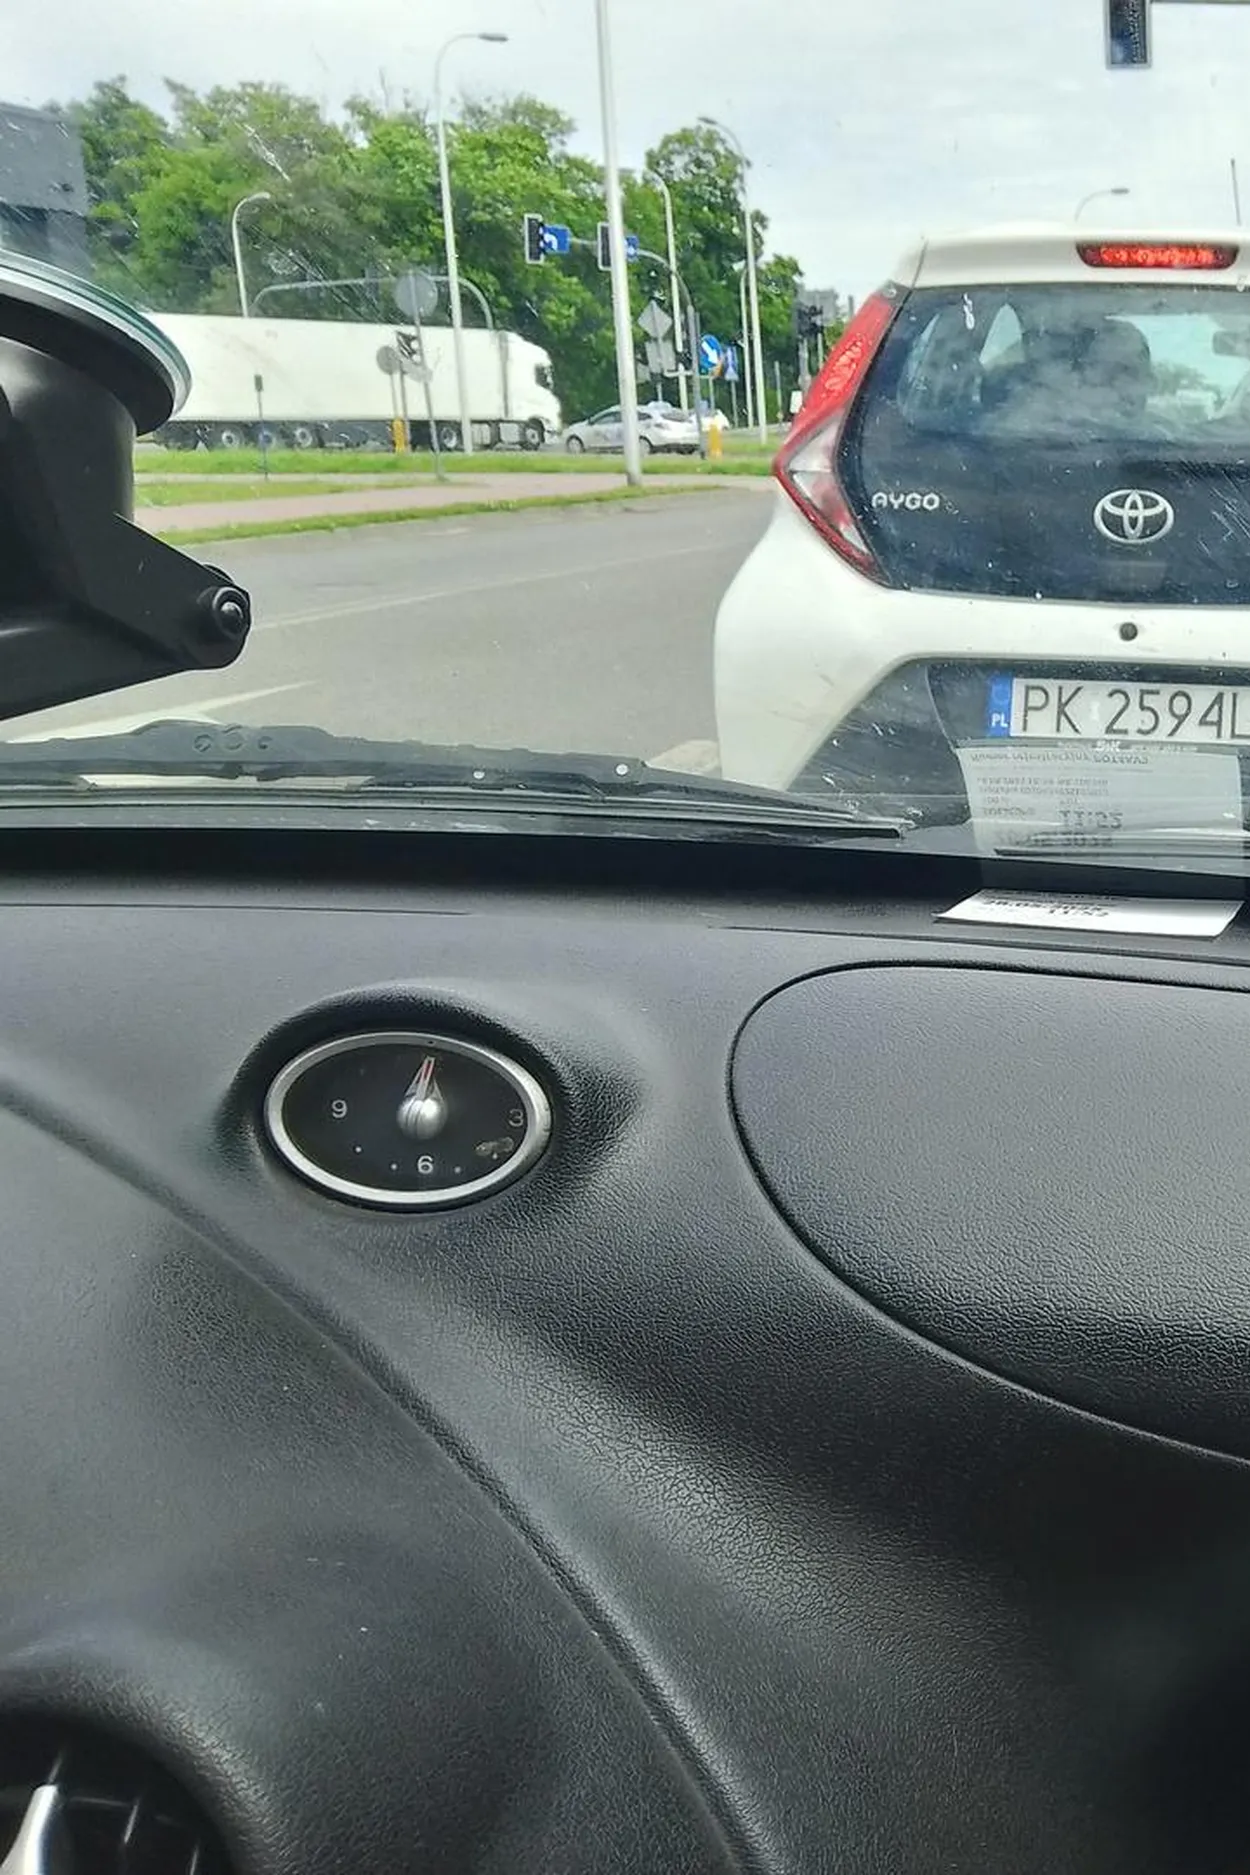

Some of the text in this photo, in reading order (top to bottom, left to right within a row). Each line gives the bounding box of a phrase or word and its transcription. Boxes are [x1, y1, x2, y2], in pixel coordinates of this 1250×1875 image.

[871, 491, 941, 511] AYGO
[1021, 684, 1085, 735] PK
[990, 713, 1008, 728] PL
[331, 1099, 348, 1119] 9
[508, 1108, 524, 1128] 3
[416, 1155, 434, 1175] 6
